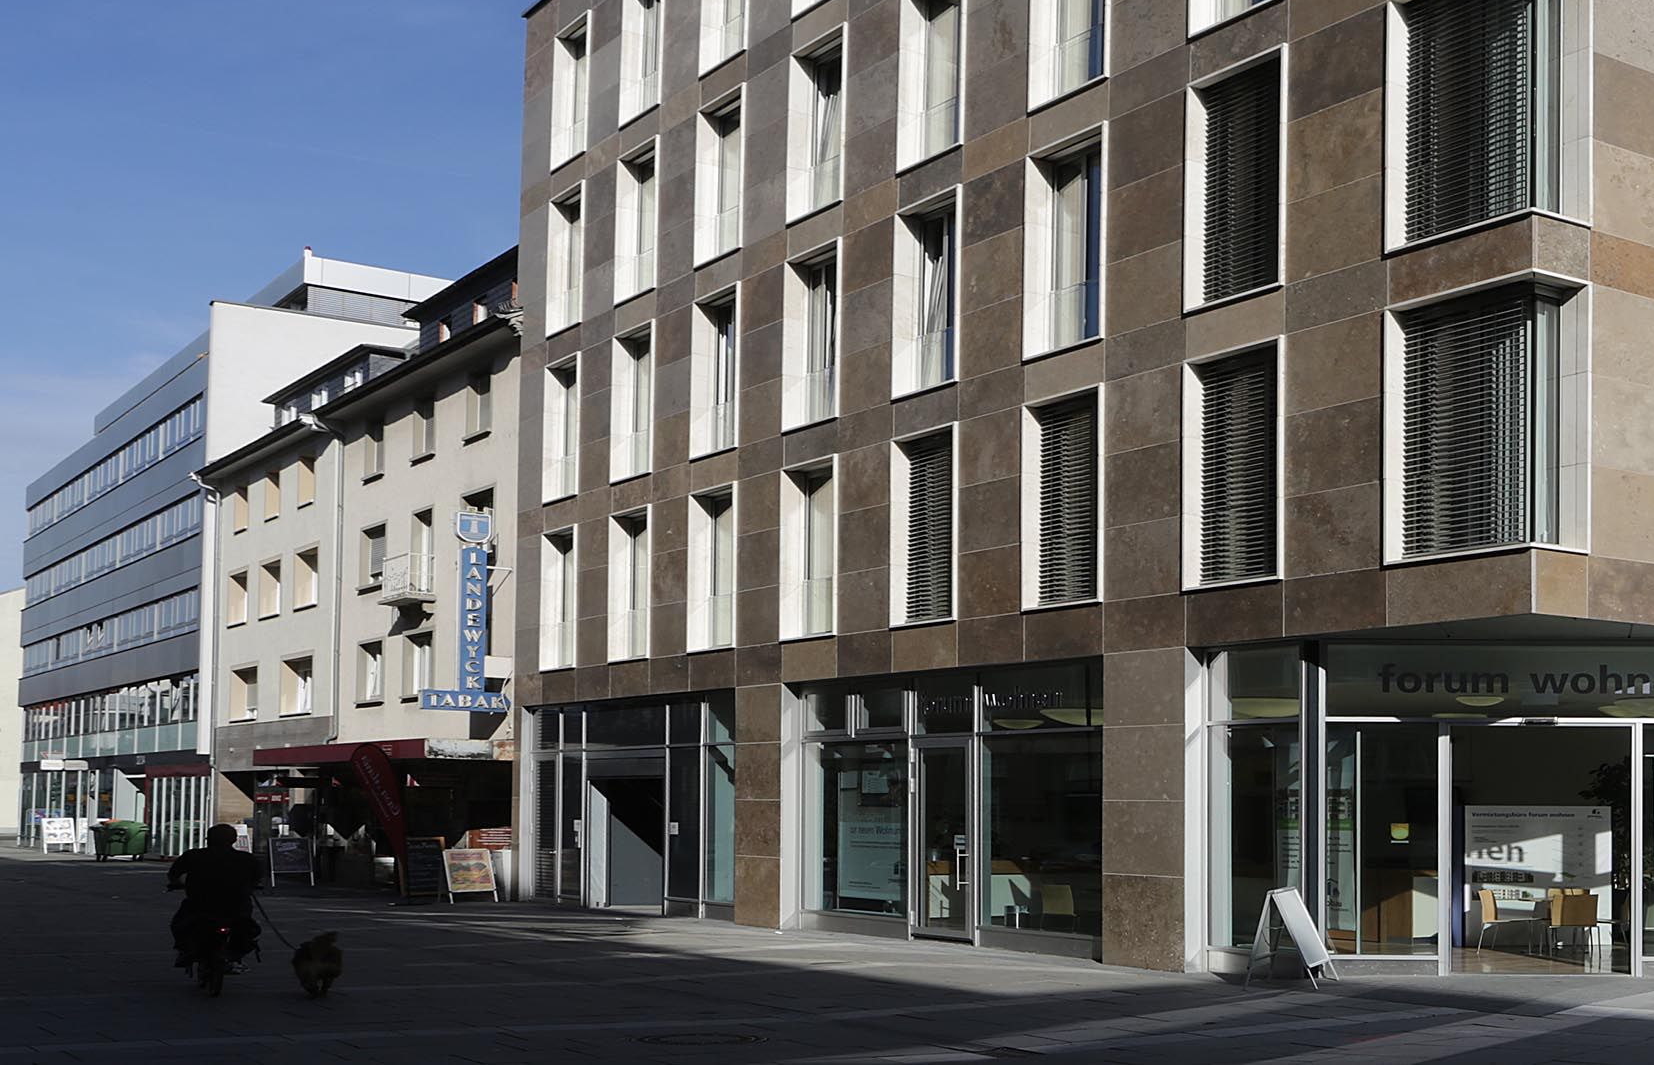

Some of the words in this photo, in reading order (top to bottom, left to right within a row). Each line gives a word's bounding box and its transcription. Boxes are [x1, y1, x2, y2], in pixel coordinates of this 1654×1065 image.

[463, 550, 484, 690] LANDEWYCK
[1377, 663, 1509, 694] forum
[428, 692, 506, 709] TABAK
